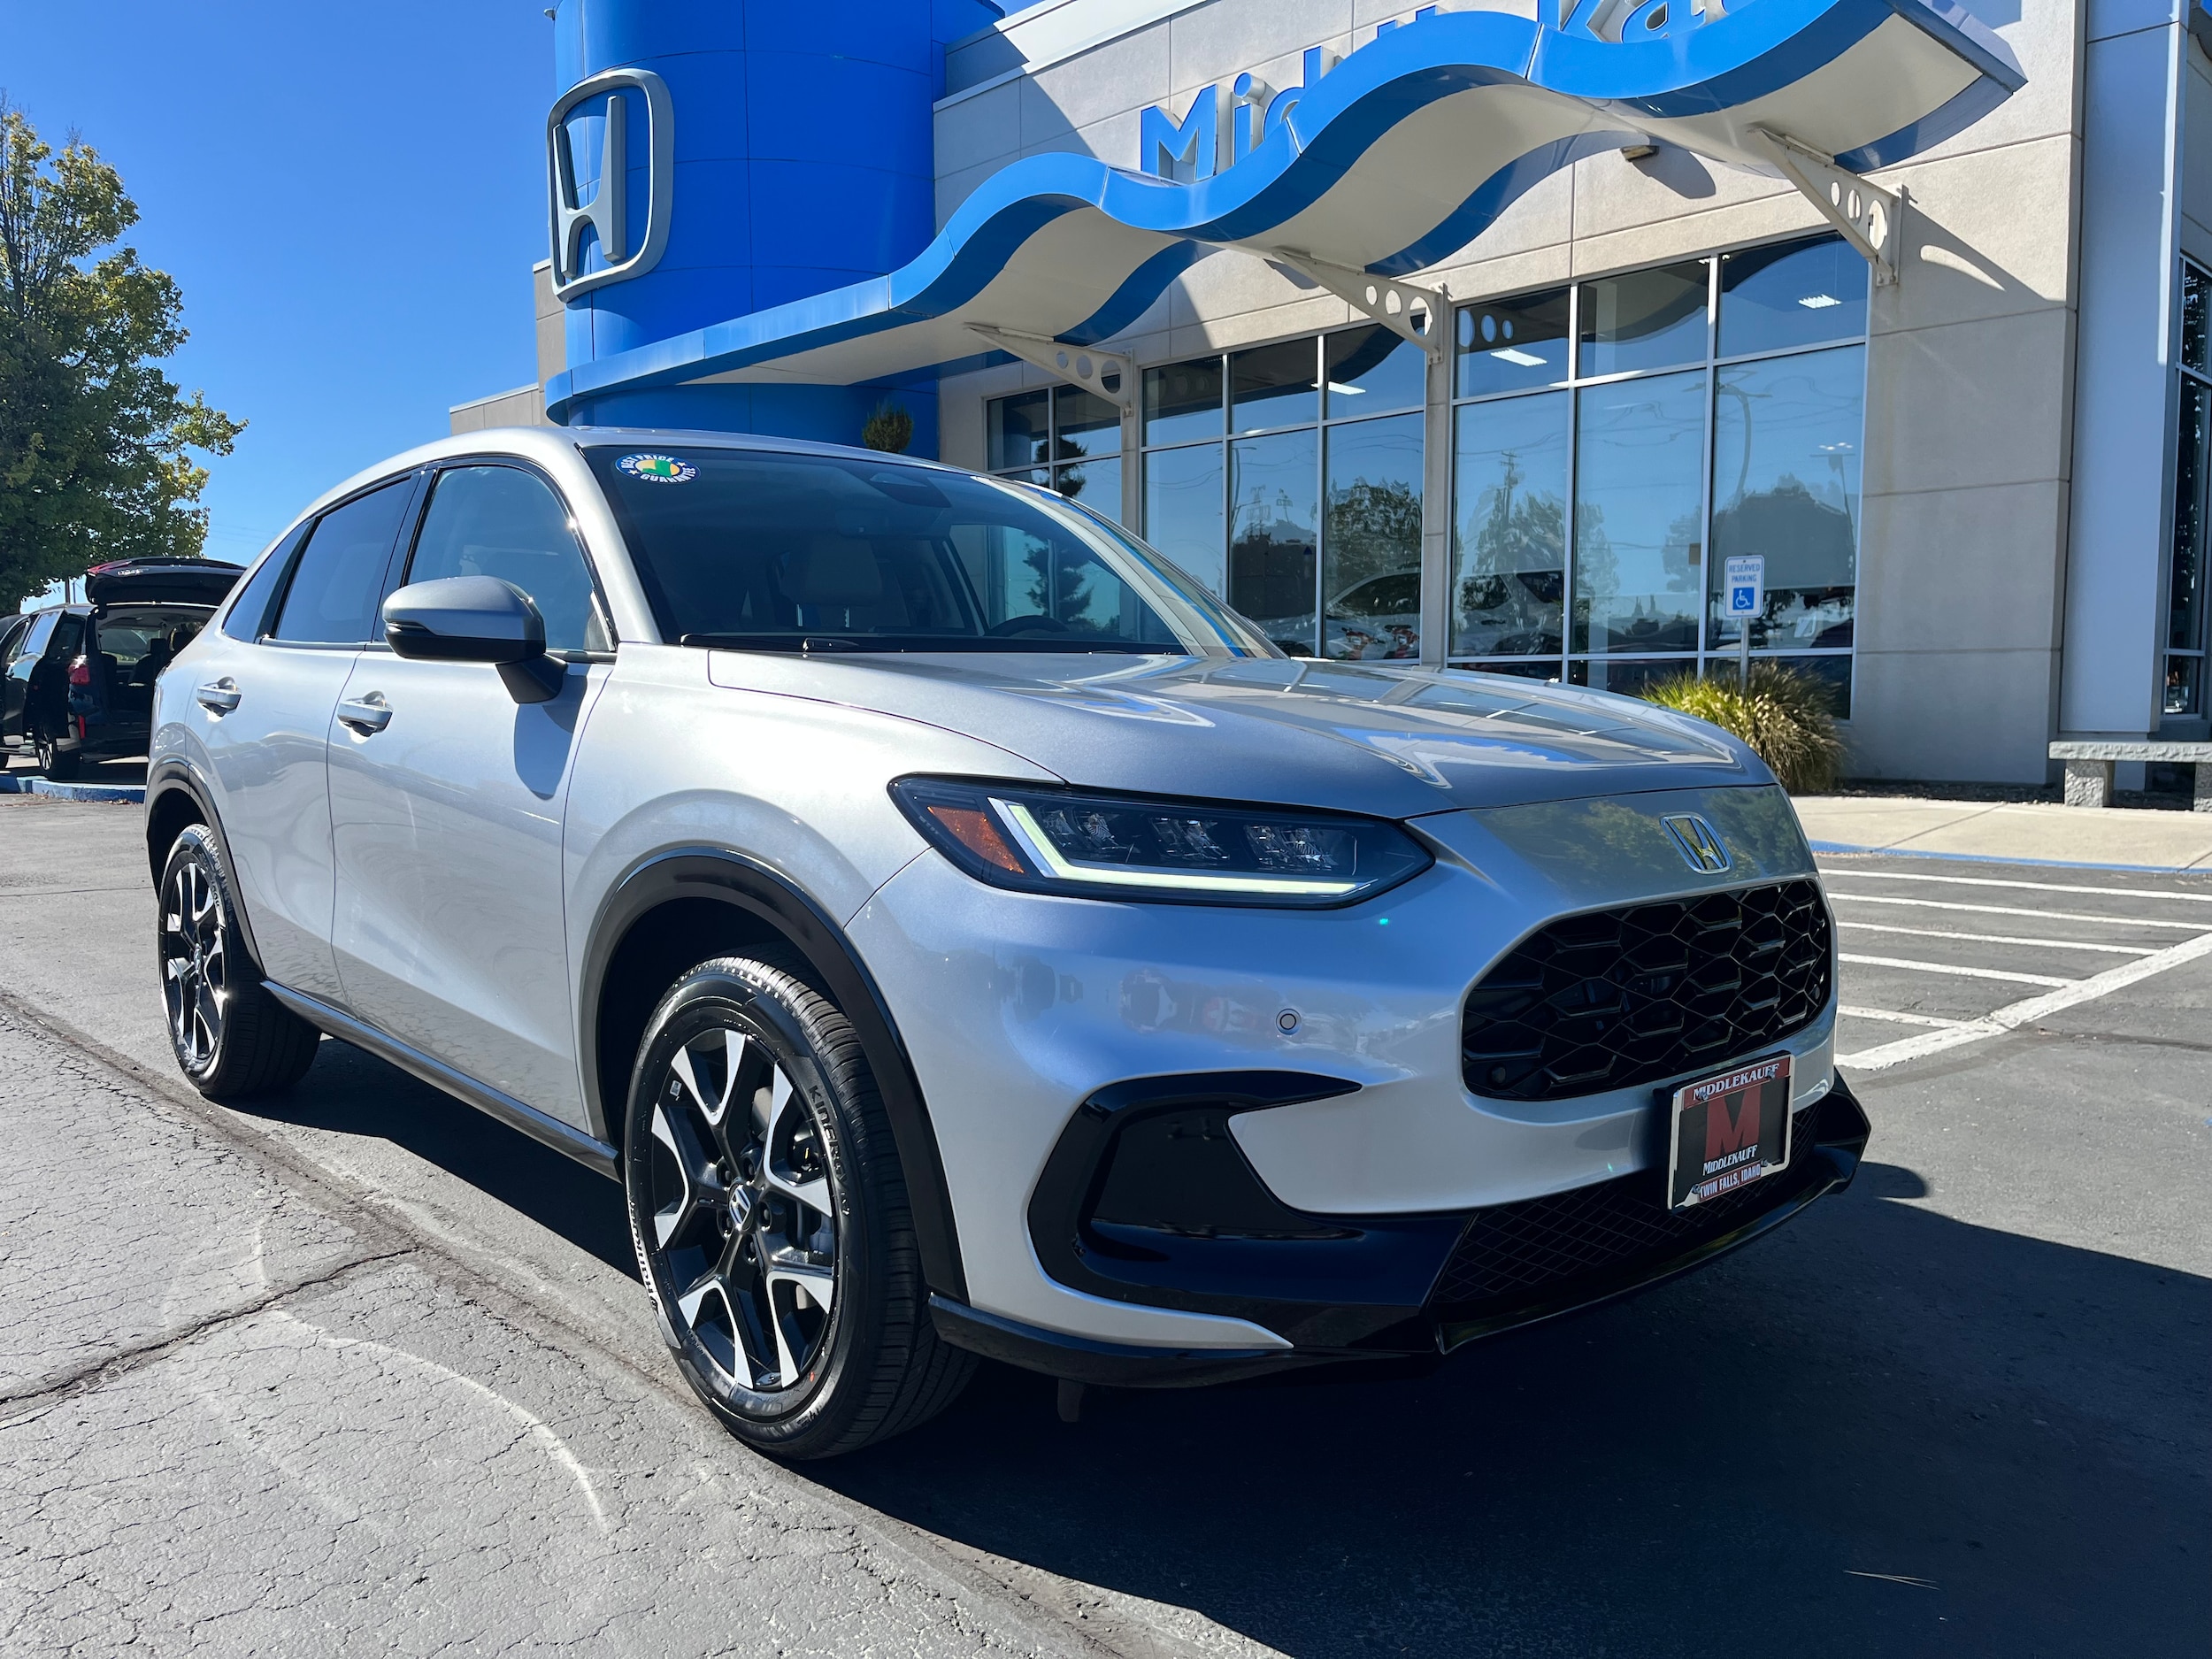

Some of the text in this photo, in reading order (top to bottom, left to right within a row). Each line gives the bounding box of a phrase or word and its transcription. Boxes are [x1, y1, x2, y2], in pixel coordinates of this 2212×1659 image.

[636, 454, 674, 463] PRICE
[640, 467, 696, 483] GUARANTEE
[1728, 564, 1761, 572] RESERVED
[1704, 1084, 1762, 1162] M
[1702, 1144, 1758, 1176] MIDDLEKAUFF
[1700, 1164, 1761, 1198] TWIN FALLS, IDAHO
